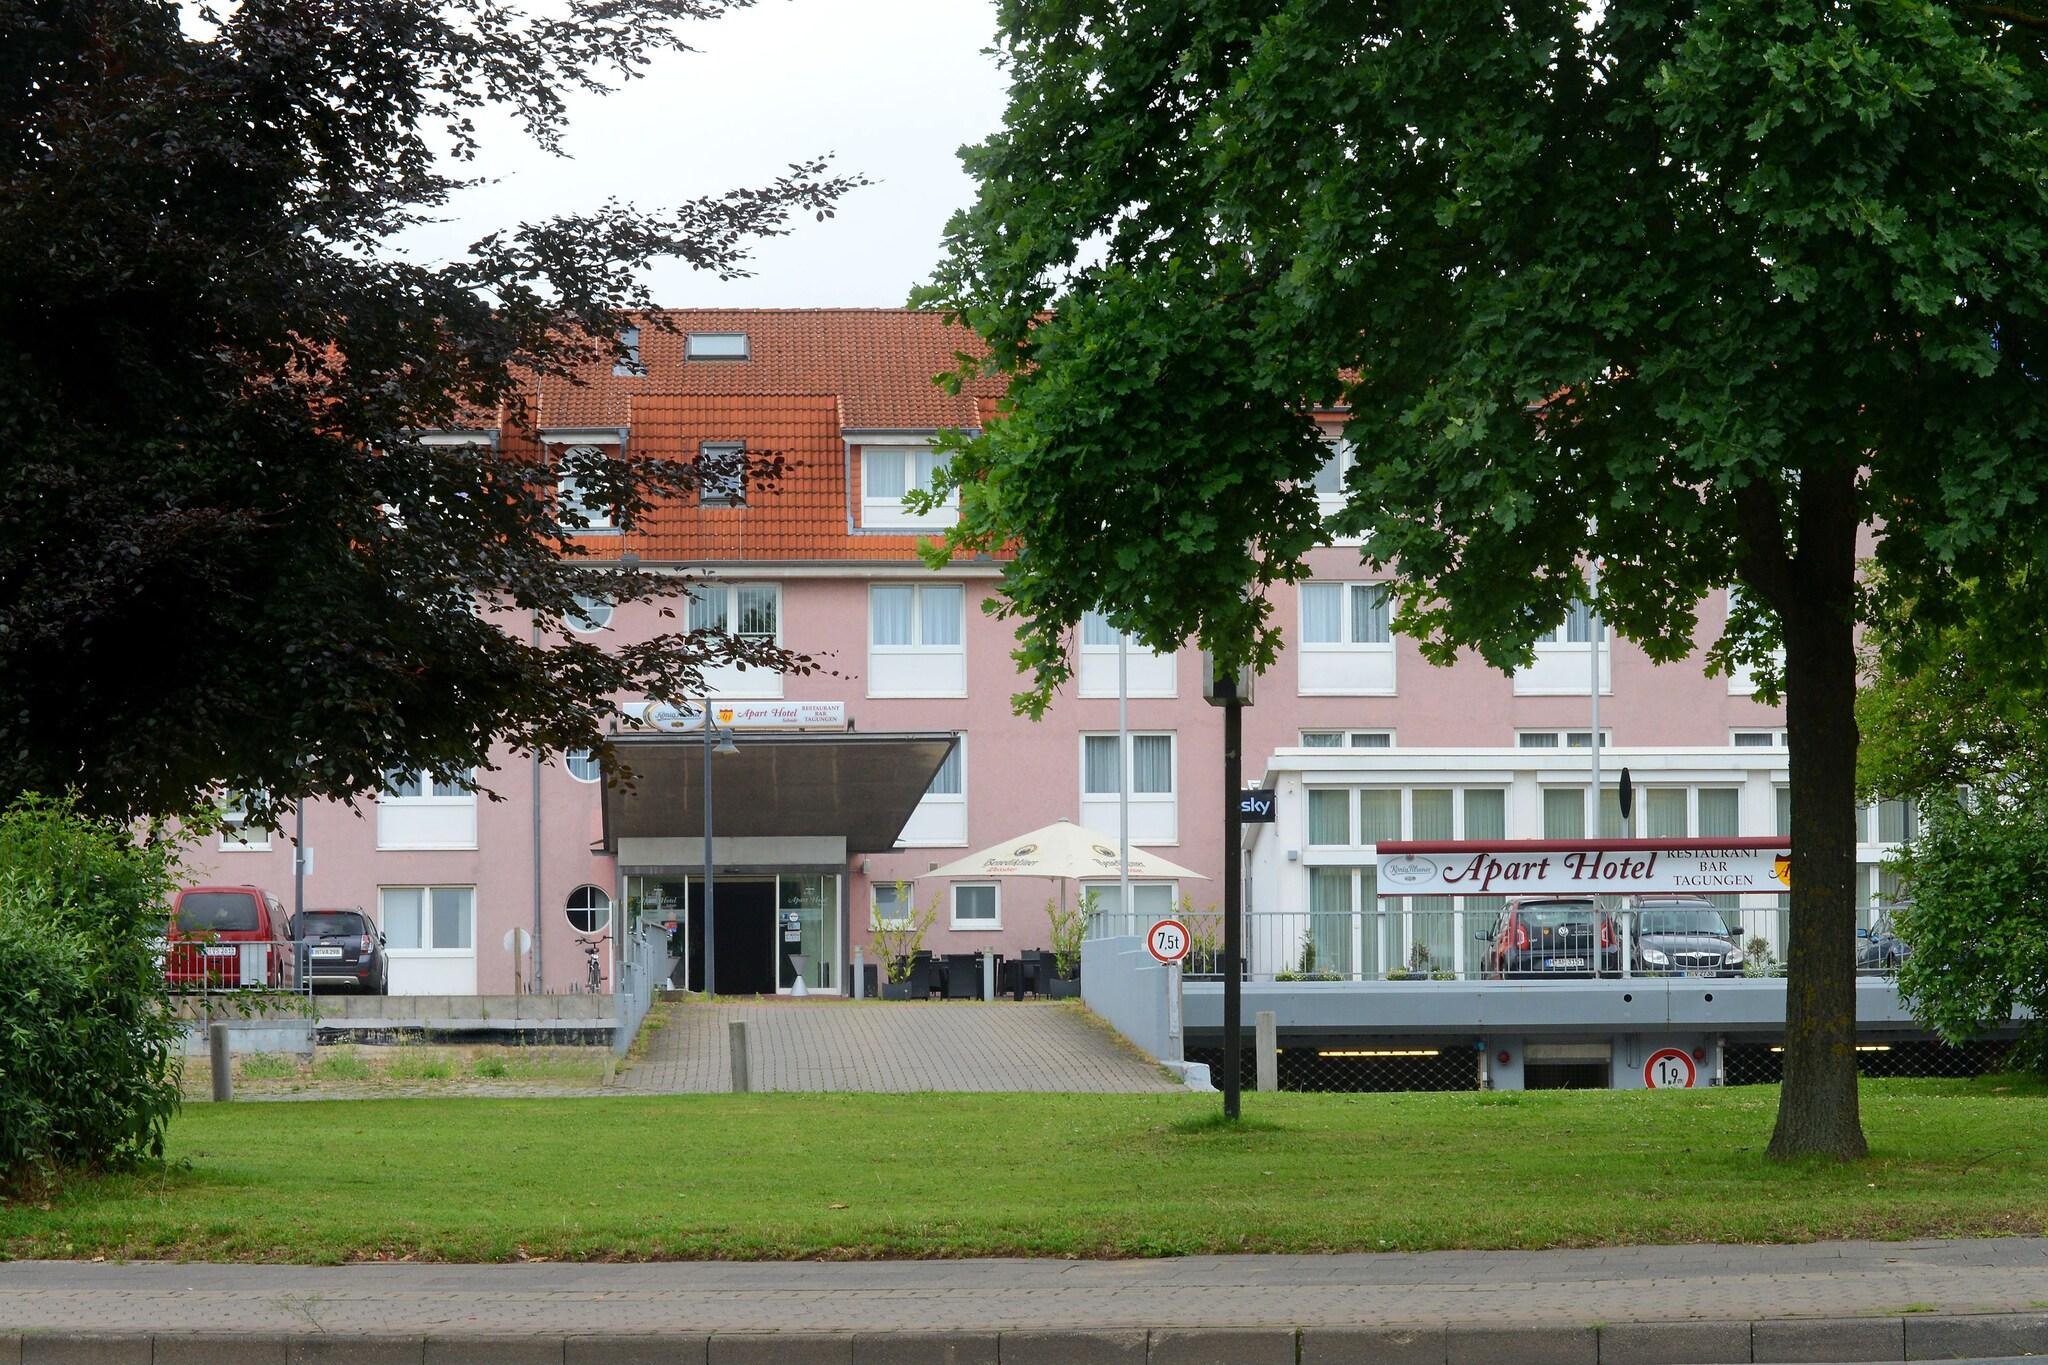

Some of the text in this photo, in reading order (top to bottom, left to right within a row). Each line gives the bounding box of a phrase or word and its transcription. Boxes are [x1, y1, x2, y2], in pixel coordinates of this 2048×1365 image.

[737, 706, 798, 720] Apart Hotel
[1241, 797, 1270, 815] sky
[1667, 848, 1759, 859] RESTAURANT
[1442, 852, 1658, 892] Apart Hotel
[1699, 861, 1728, 873] BAR
[1672, 874, 1754, 886] TAGUNGEN
